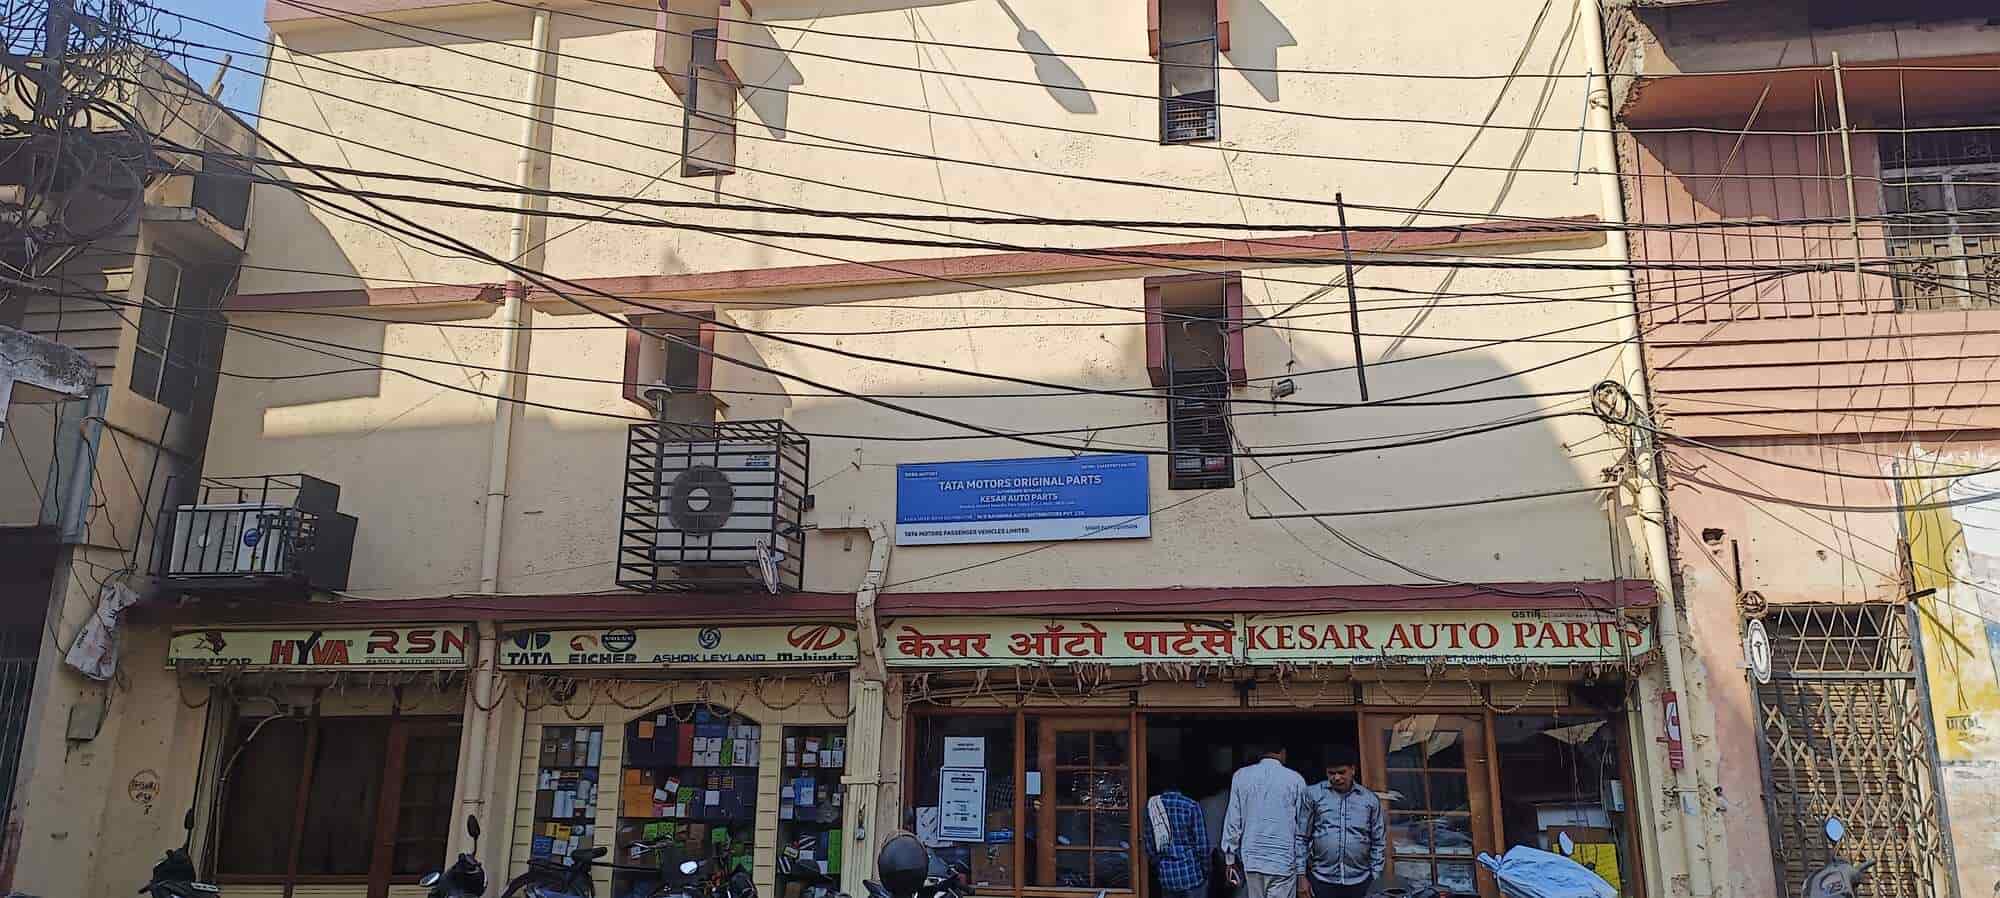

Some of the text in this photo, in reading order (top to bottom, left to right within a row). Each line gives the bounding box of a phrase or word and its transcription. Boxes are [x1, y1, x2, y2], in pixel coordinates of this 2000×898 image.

[939, 474, 1102, 492] TATA MOTORS ORIGINAL PARTS
[980, 492, 1058, 503] KESAR AUTO PARTS
[366, 629, 469, 654] RSN
[896, 625, 991, 658] केसर
[1246, 623, 1373, 651] KESAR
[1385, 622, 1500, 649] AUTO
[269, 632, 349, 665] HYVA
[507, 652, 553, 665] TATA
[568, 653, 639, 665] EICHER
[652, 653, 766, 663] ASHOK LEYLAND
